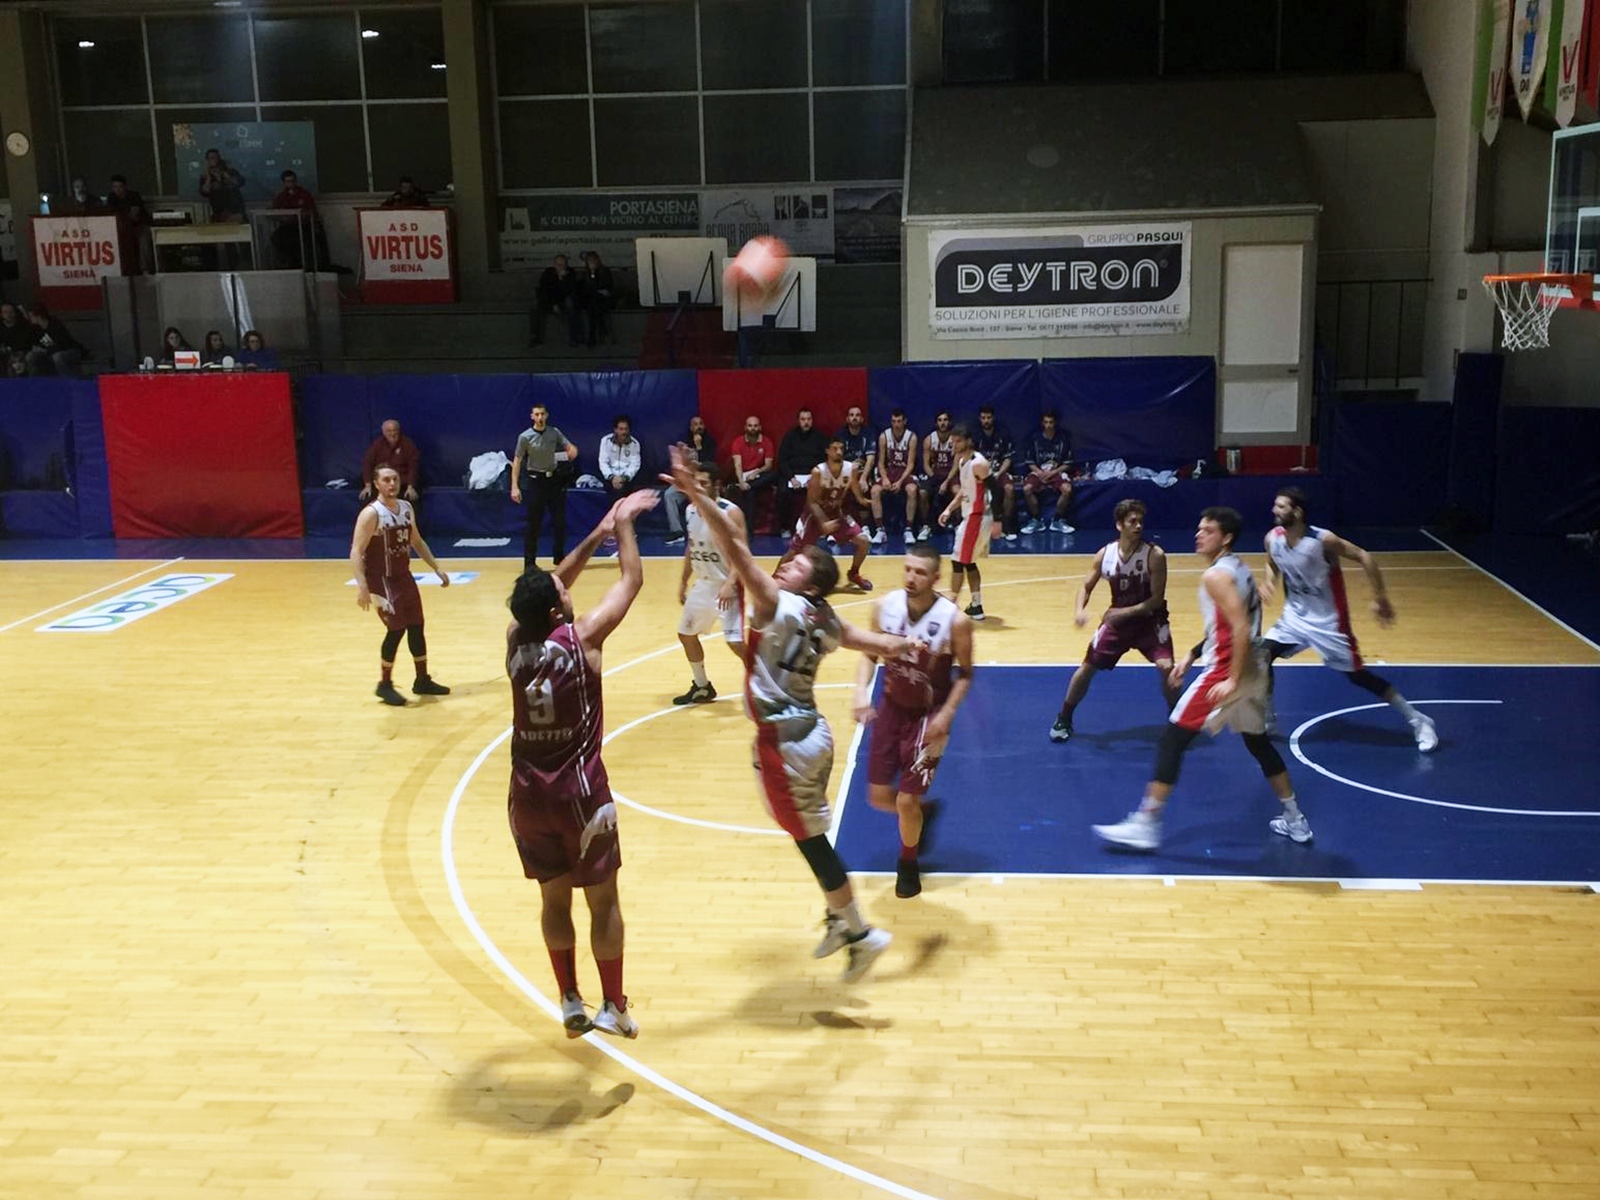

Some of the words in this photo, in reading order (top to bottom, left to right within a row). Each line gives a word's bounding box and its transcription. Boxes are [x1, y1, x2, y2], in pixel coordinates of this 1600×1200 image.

[609, 199, 698, 216] PORTASIENA
[551, 215, 589, 226] CENTRO
[609, 214, 646, 225] VICINO
[648, 214, 660, 225] AL
[40, 240, 116, 267] VIRTUS
[366, 234, 444, 261] VIRTUS
[62, 269, 96, 279] SIENA
[389, 263, 424, 273] SIENA
[957, 258, 1160, 294] DEYTRON
[935, 309, 1001, 321] SOLUZIONI
[1003, 309, 1027, 320] PER
[1028, 307, 1079, 319] L'IGIENE
[1081, 304, 1181, 318] PROFESSIONALE
[396, 529, 409, 543] 34
